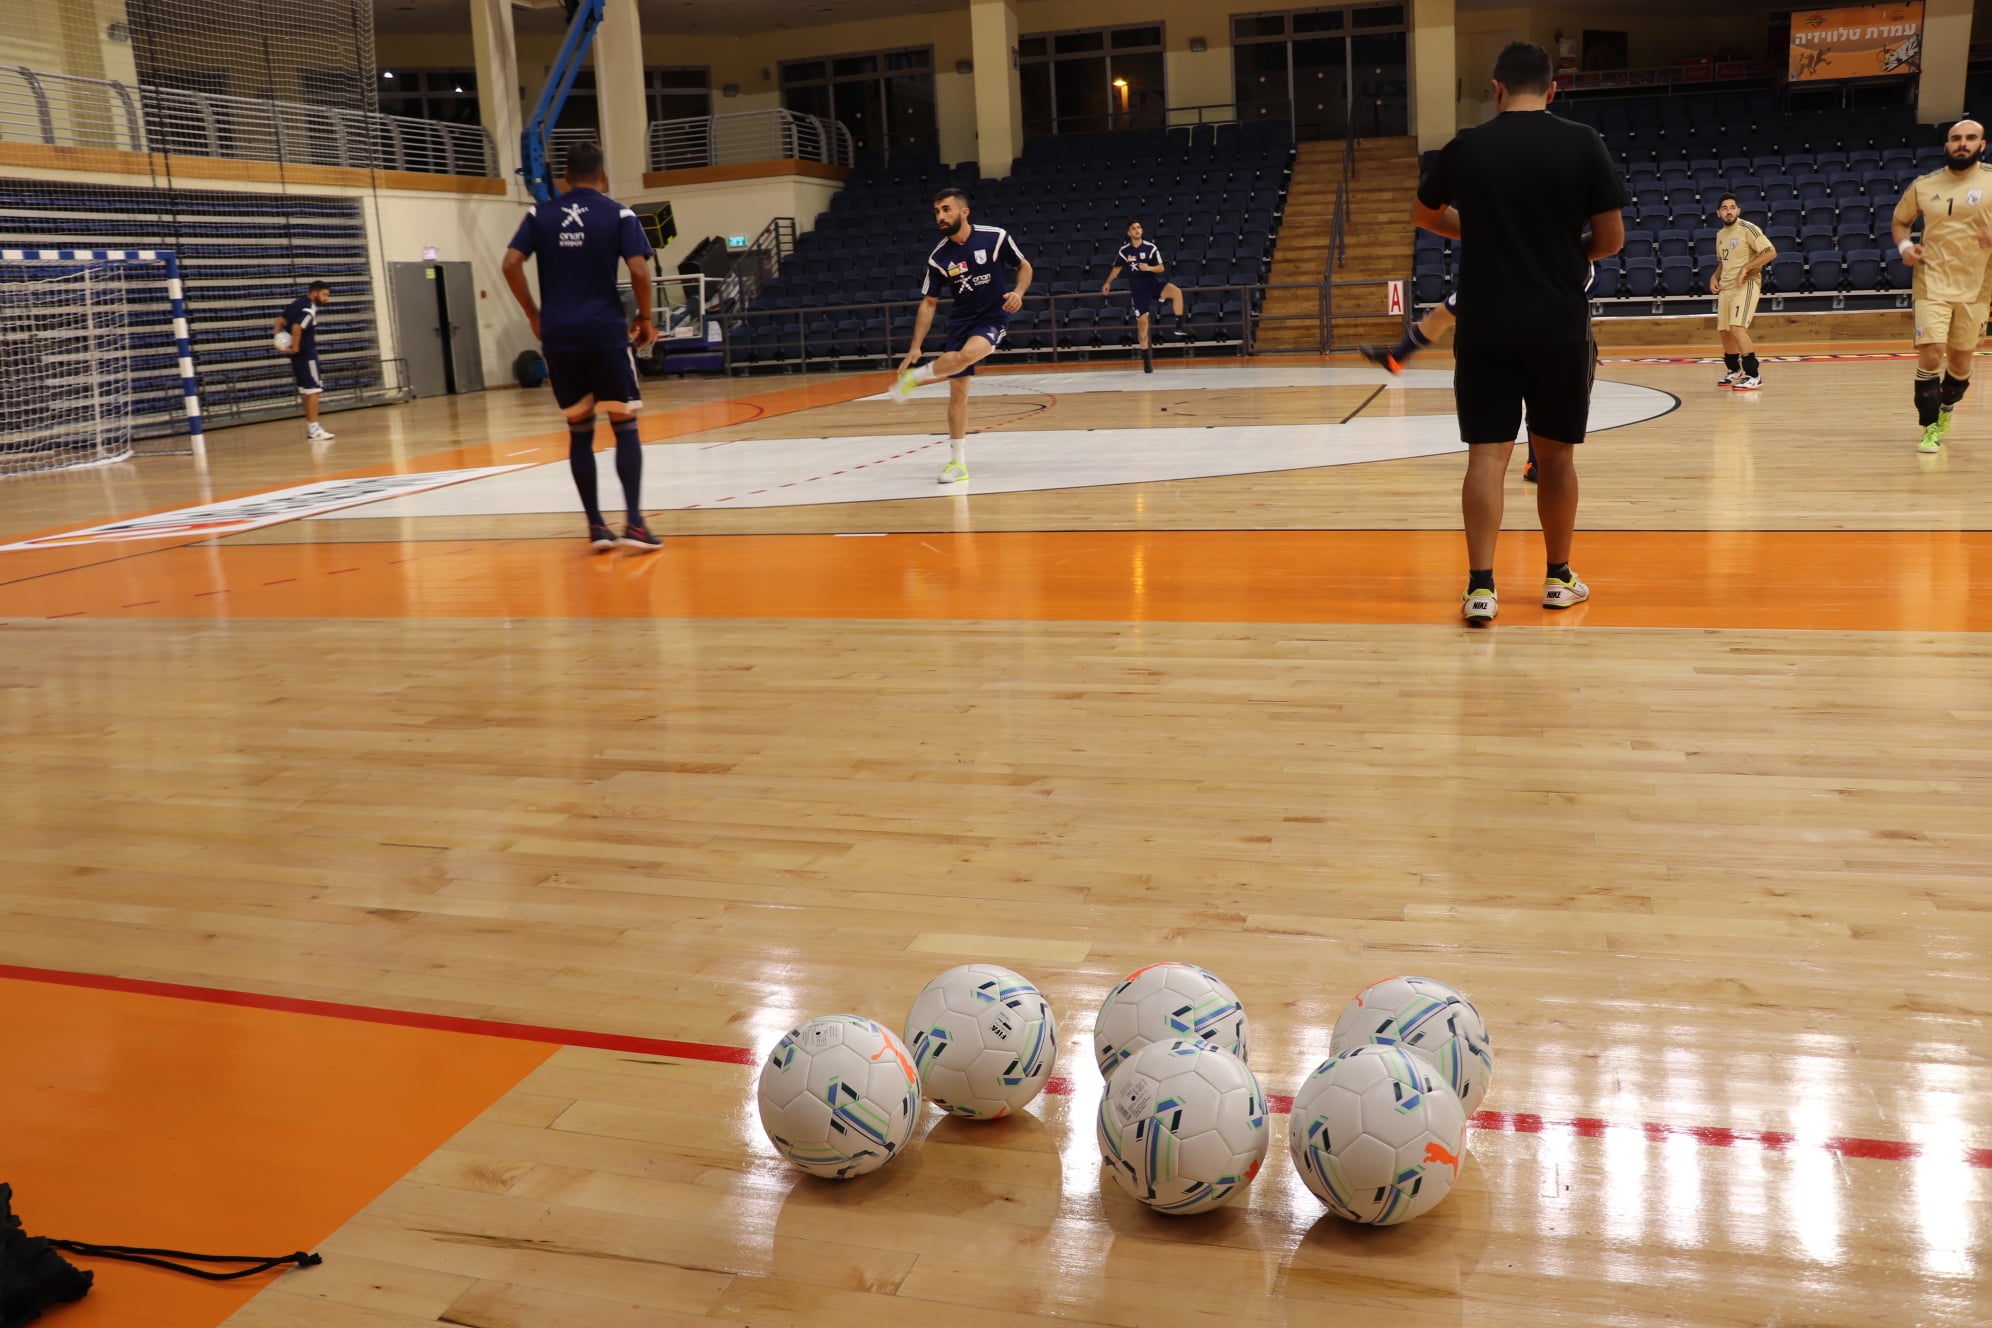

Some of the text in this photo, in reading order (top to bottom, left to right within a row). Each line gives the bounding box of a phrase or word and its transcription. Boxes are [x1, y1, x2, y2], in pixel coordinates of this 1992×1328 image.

[1795, 23, 1916, 45] עמדת טלוויזיה
[1946, 198, 1954, 216] 1
[1722, 248, 1729, 260] 12
[1391, 283, 1401, 312] A
[1545, 591, 1561, 599] NIKE
[1472, 601, 1488, 610] NIKE
[991, 1024, 1007, 1040] FIFA
